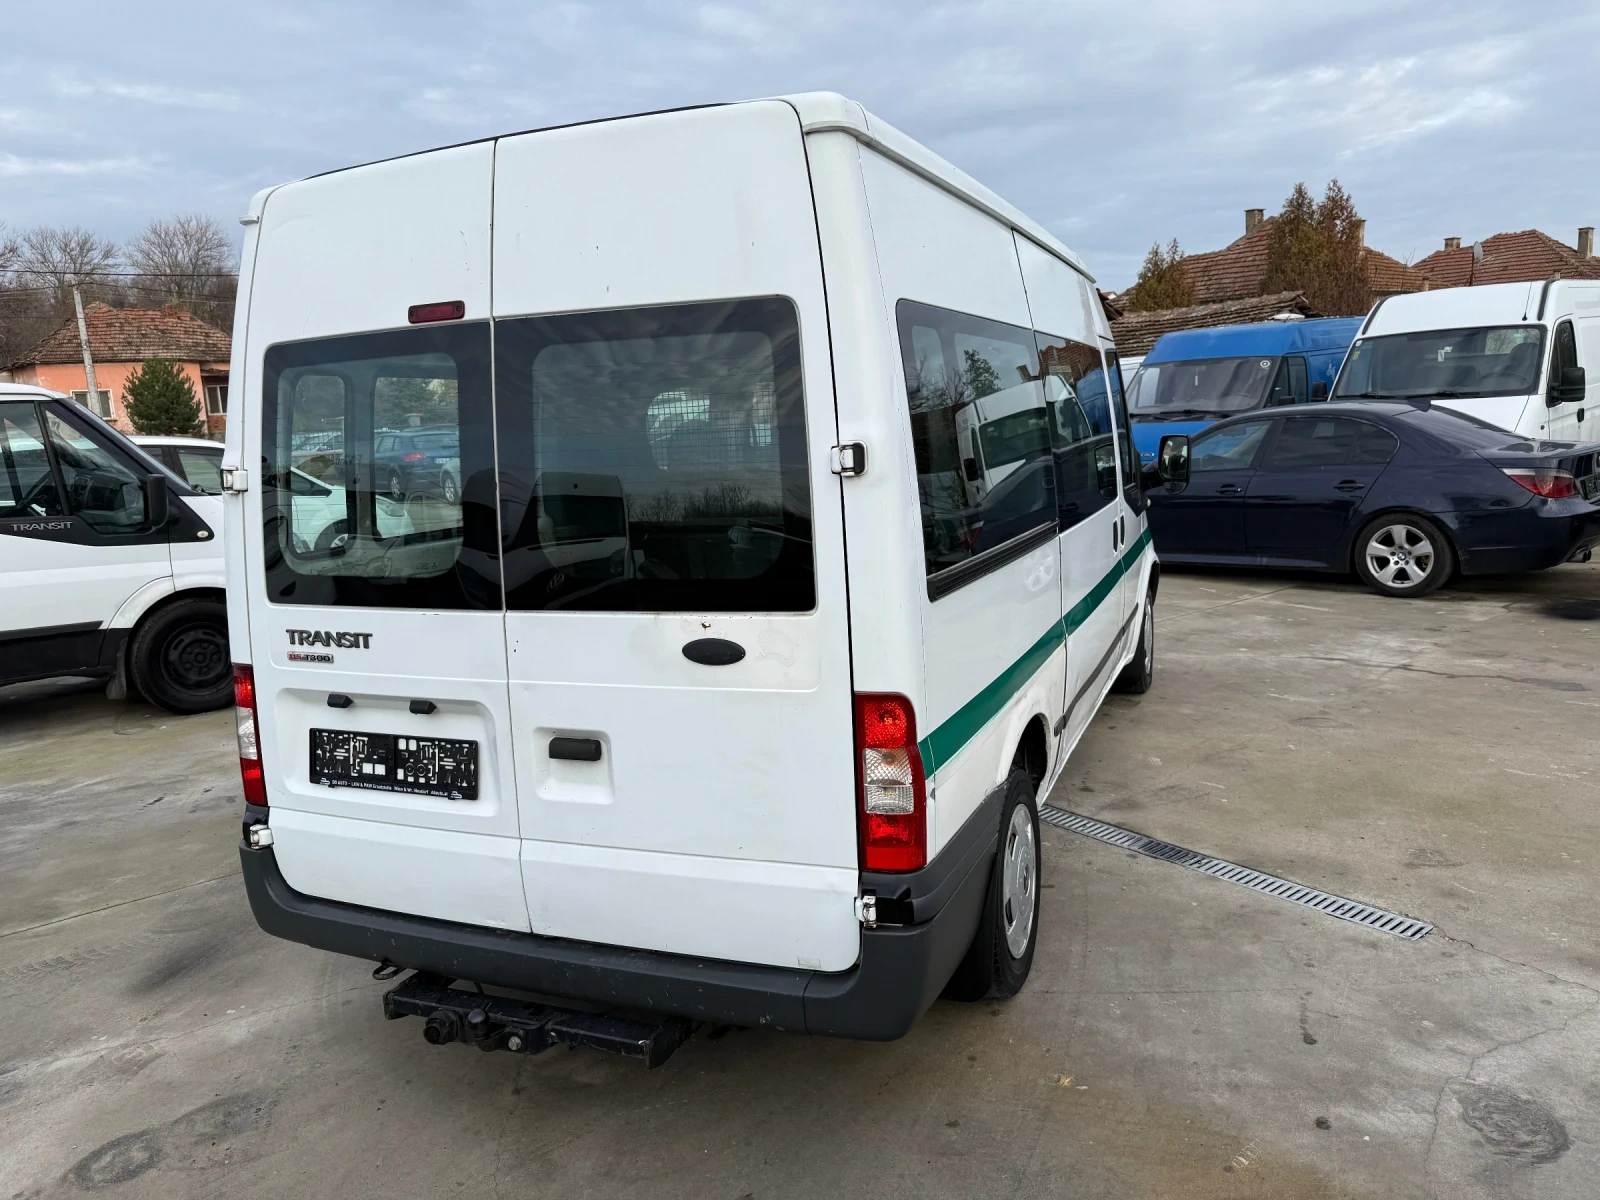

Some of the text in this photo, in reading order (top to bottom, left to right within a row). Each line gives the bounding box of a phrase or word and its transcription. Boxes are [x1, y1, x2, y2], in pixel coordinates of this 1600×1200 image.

[11, 521, 73, 531] TRANSIT
[285, 629, 373, 649] TRANSIT
[305, 654, 331, 662] T300
